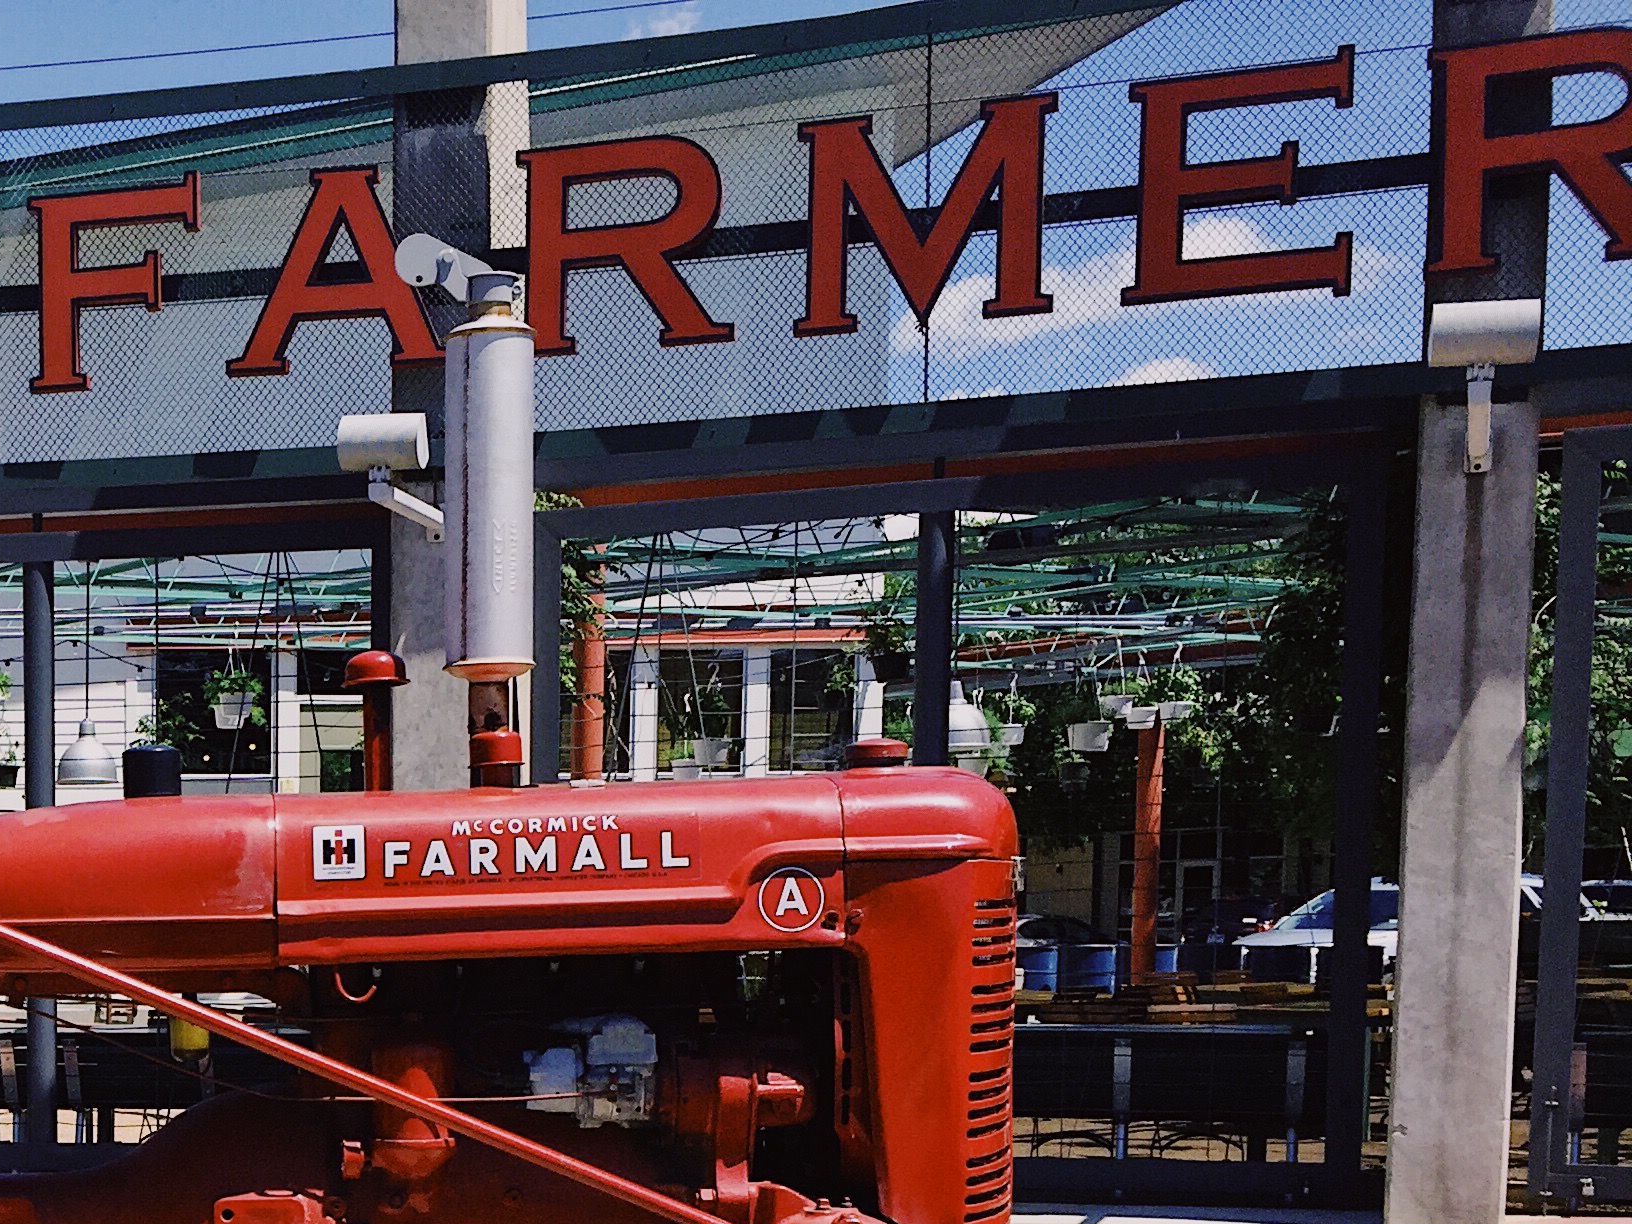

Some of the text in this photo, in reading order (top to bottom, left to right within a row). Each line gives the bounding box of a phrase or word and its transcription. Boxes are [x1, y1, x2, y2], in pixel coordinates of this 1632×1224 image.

[27, 26, 1632, 396] FARMER
[383, 830, 691, 879] FARMALL
[774, 875, 810, 918] A
